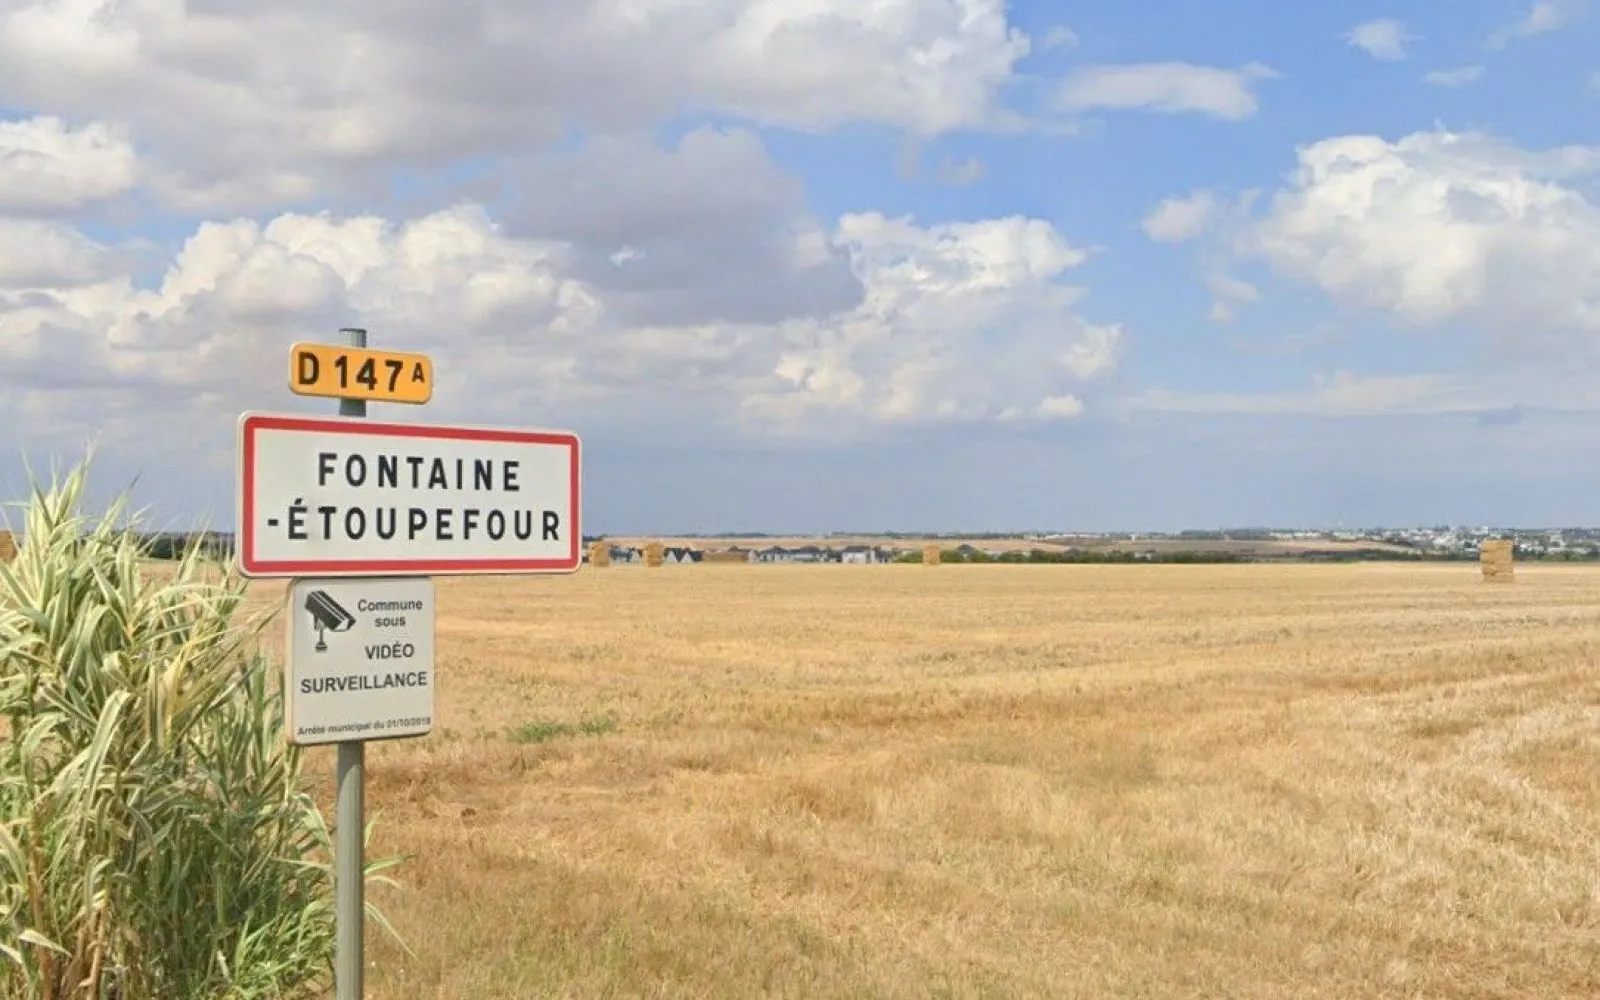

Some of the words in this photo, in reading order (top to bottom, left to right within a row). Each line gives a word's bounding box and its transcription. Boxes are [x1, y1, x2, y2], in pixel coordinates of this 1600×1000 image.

[298, 352, 319, 386] D
[318, 452, 520, 492] FONTAINE
[267, 498, 560, 541] -ÉTOUPEFOUR
[357, 599, 423, 613] Commune
[374, 616, 406, 627] sous
[365, 641, 415, 660] VIDÉO
[300, 671, 428, 694] SURVEILLANCE
[328, 721, 372, 734] municipal
[374, 720, 384, 729] du
